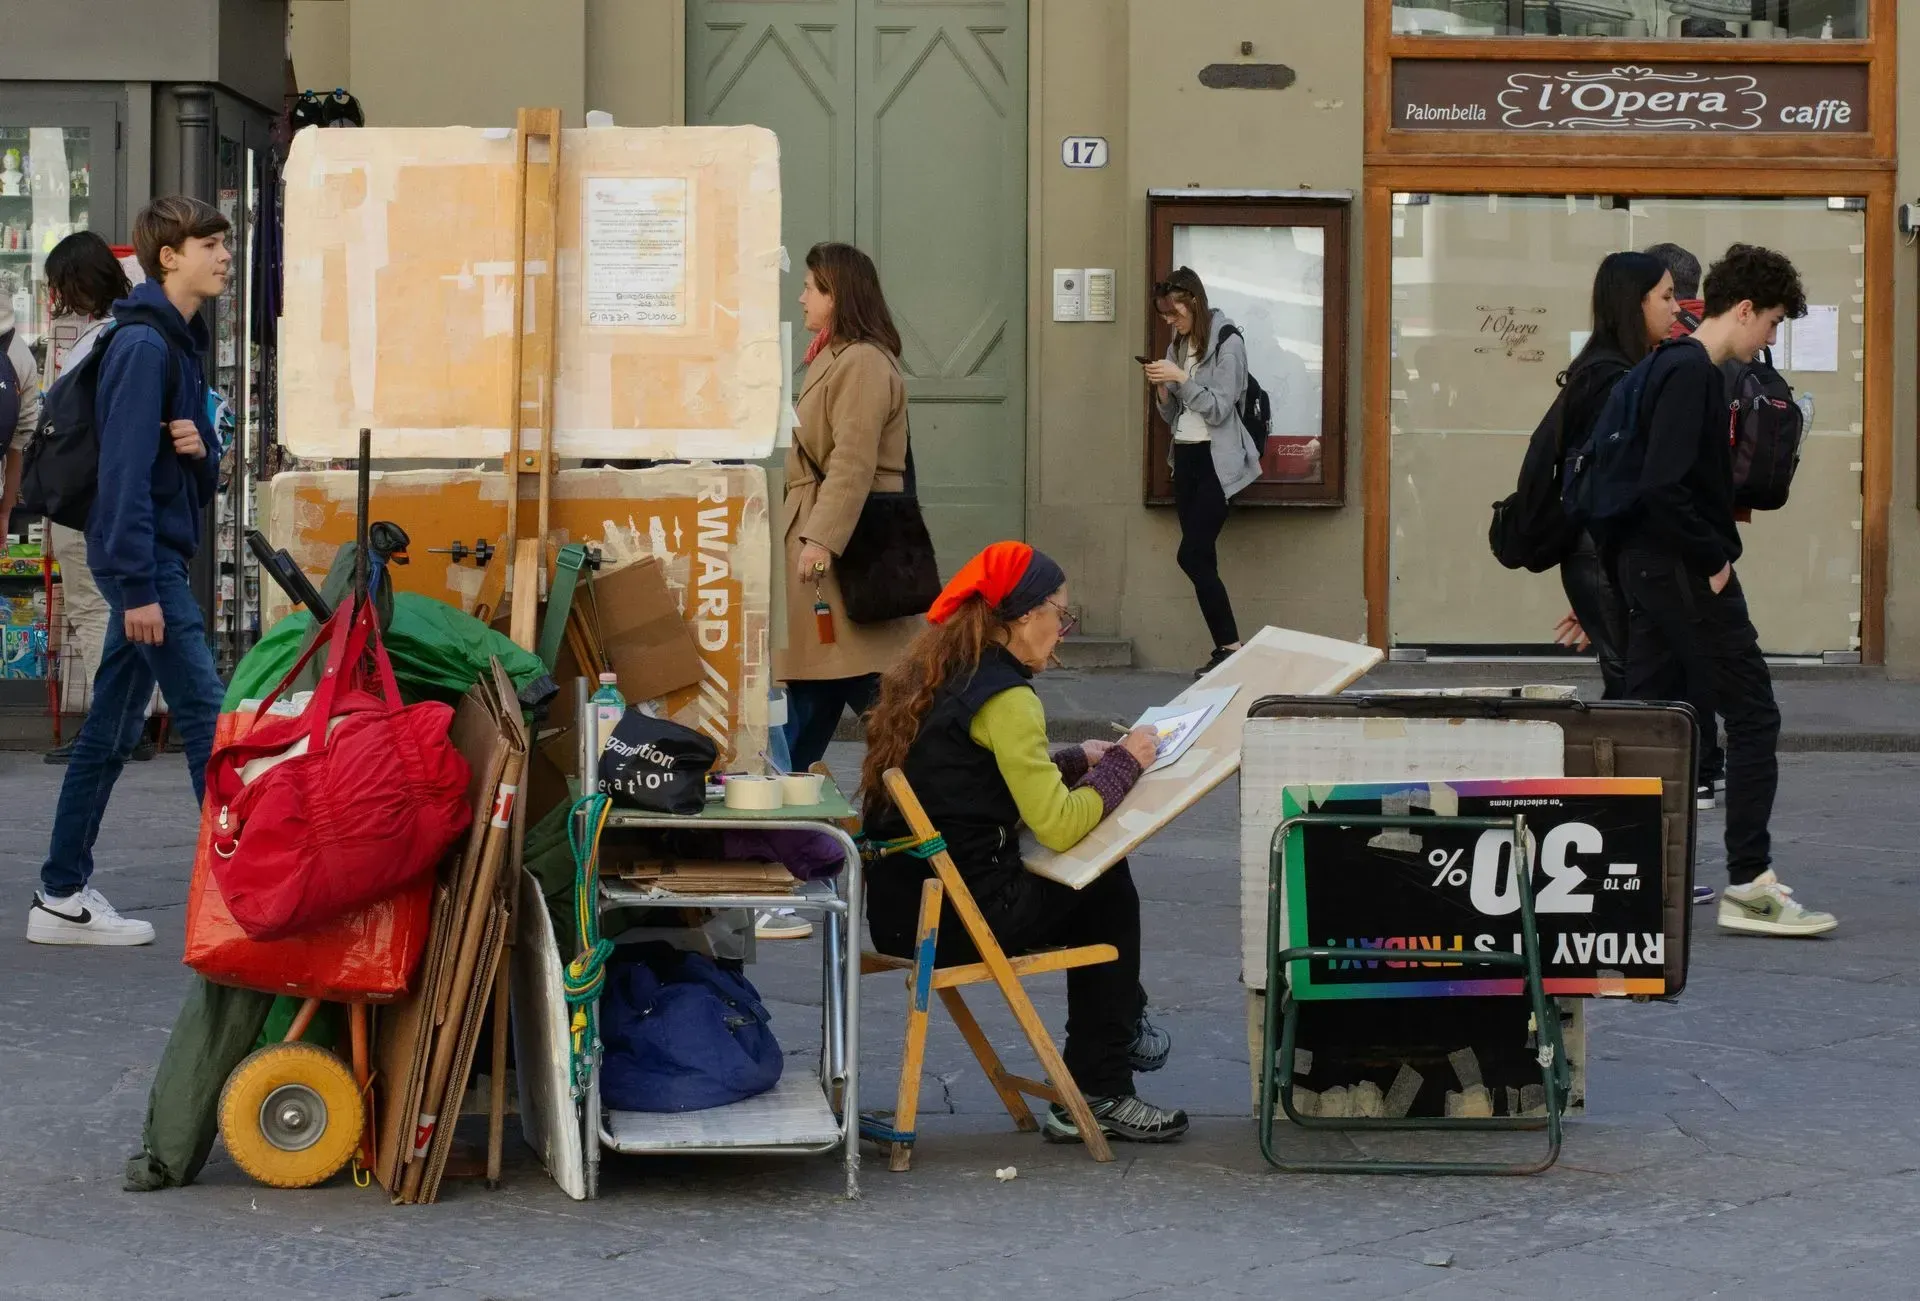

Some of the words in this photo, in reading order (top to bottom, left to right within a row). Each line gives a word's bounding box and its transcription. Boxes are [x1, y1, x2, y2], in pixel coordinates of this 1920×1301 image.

[1405, 103, 1487, 122] Palombella
[1538, 82, 1728, 118] l'Opera
[1780, 100, 1852, 130] caffè
[1069, 141, 1099, 165] 17
[1479, 314, 1539, 341] l'Opera
[1489, 798, 1512, 808] items
[1513, 798, 1548, 808] selected
[1603, 877, 1620, 890] TO
[1623, 877, 1641, 890] UP
